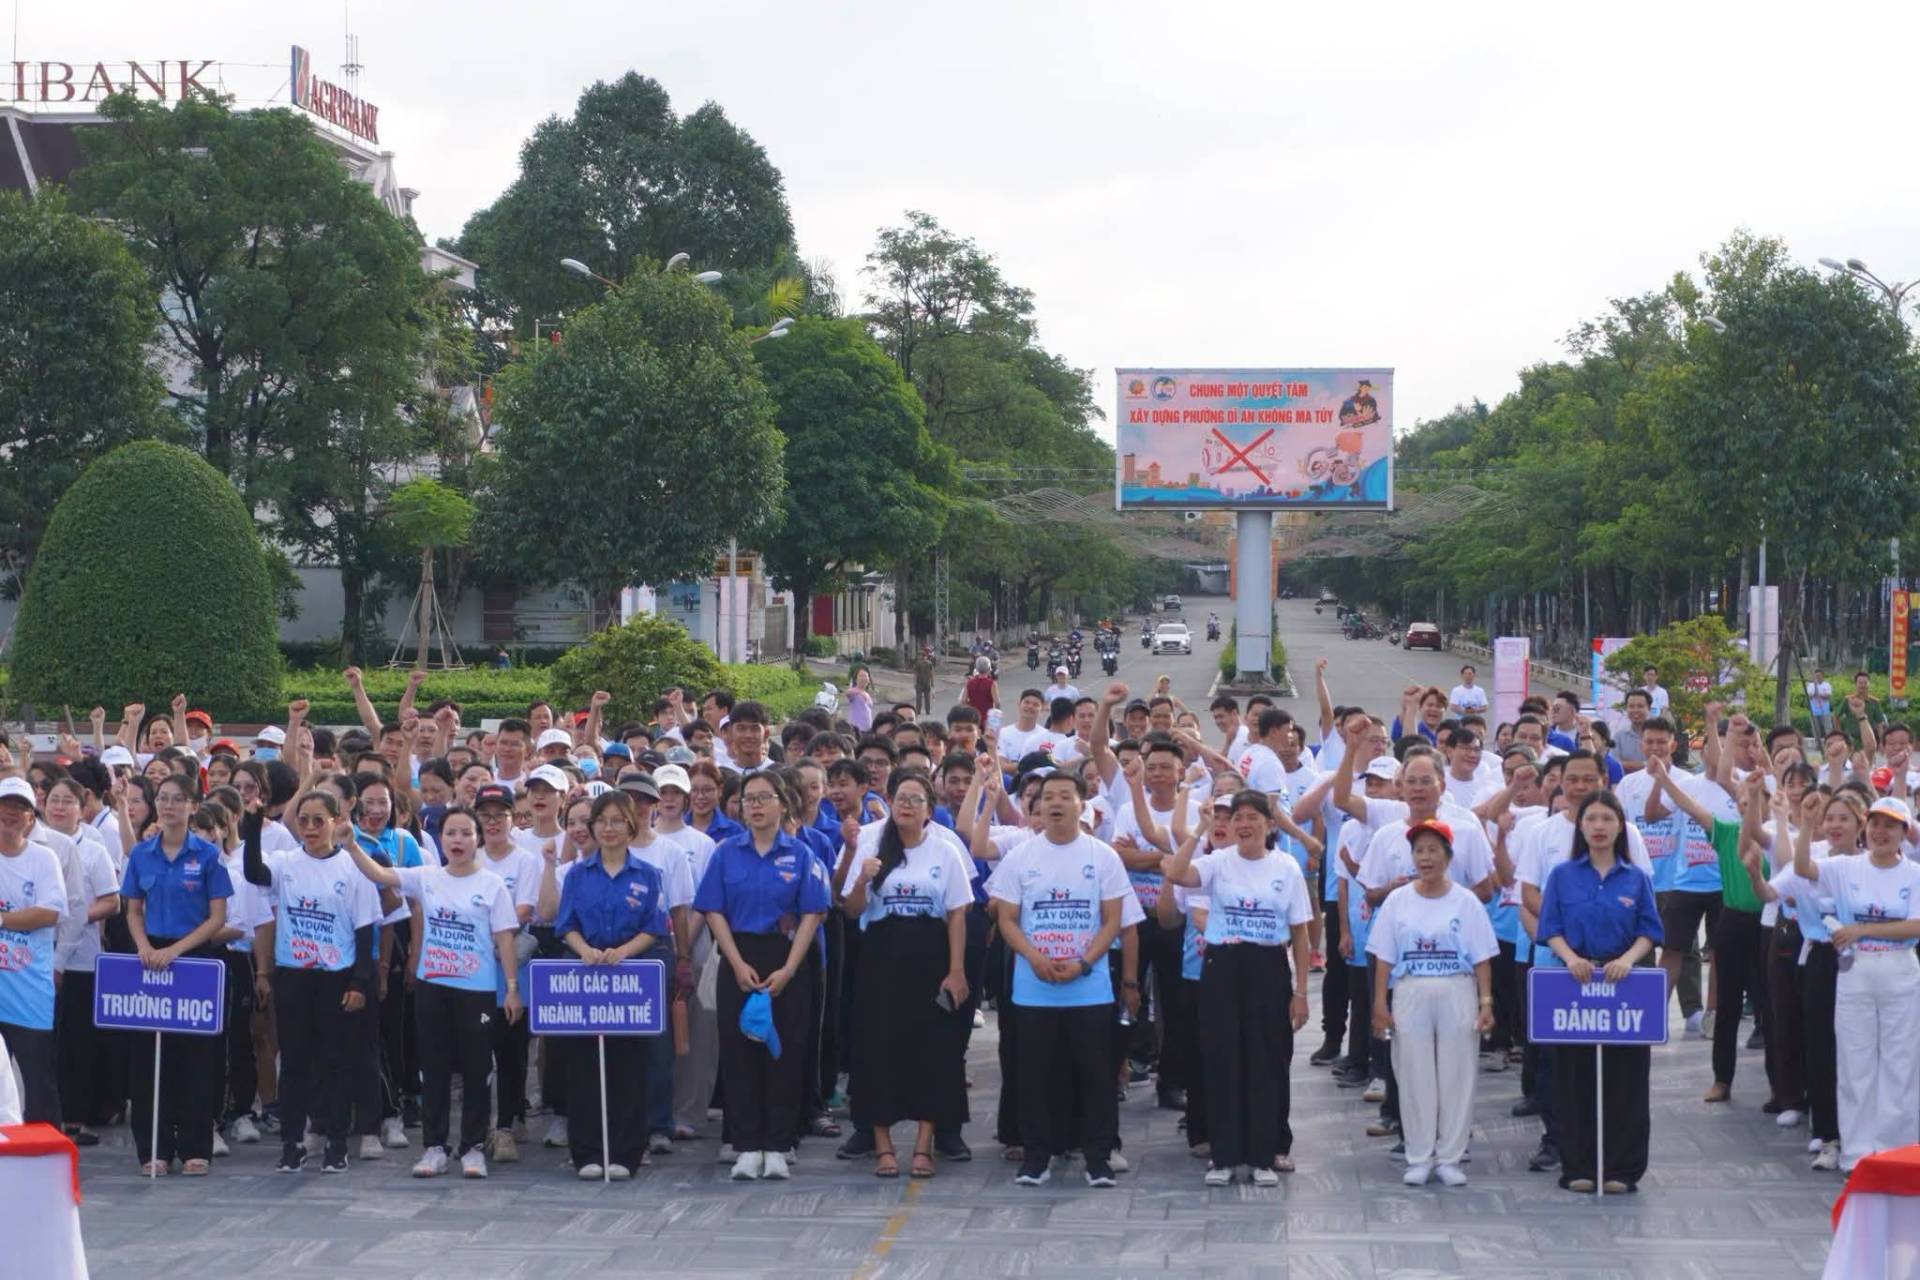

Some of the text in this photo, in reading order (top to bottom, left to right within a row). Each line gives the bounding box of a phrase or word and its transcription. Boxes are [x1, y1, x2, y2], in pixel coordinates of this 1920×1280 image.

[0, 60, 217, 101] IBANK
[311, 73, 379, 144] AGRIBANK
[1189, 383, 1224, 398] CHUNG
[1227, 382, 1248, 399] MỘT
[1286, 382, 1308, 398] TÂM
[1130, 408, 1148, 423] XÂY
[1152, 409, 1180, 426] DỰNG
[1183, 408, 1224, 423] PHƯỜNG
[1241, 409, 1255, 423] AN
[1258, 407, 1293, 423] KHÔNG
[1296, 409, 1311, 423] MA
[1315, 408, 1334, 423] TÚY
[1059, 909, 1091, 922] DỰNG
[549, 968, 643, 995] KHỐI CÁC BAN,
[101, 990, 214, 1026] TRƯỜNG HỌC
[538, 1001, 587, 1027] NGÀNH,
[589, 1001, 625, 1024] ĐOÀN
[1552, 1001, 1644, 1032] ĐẢNG ỦY
